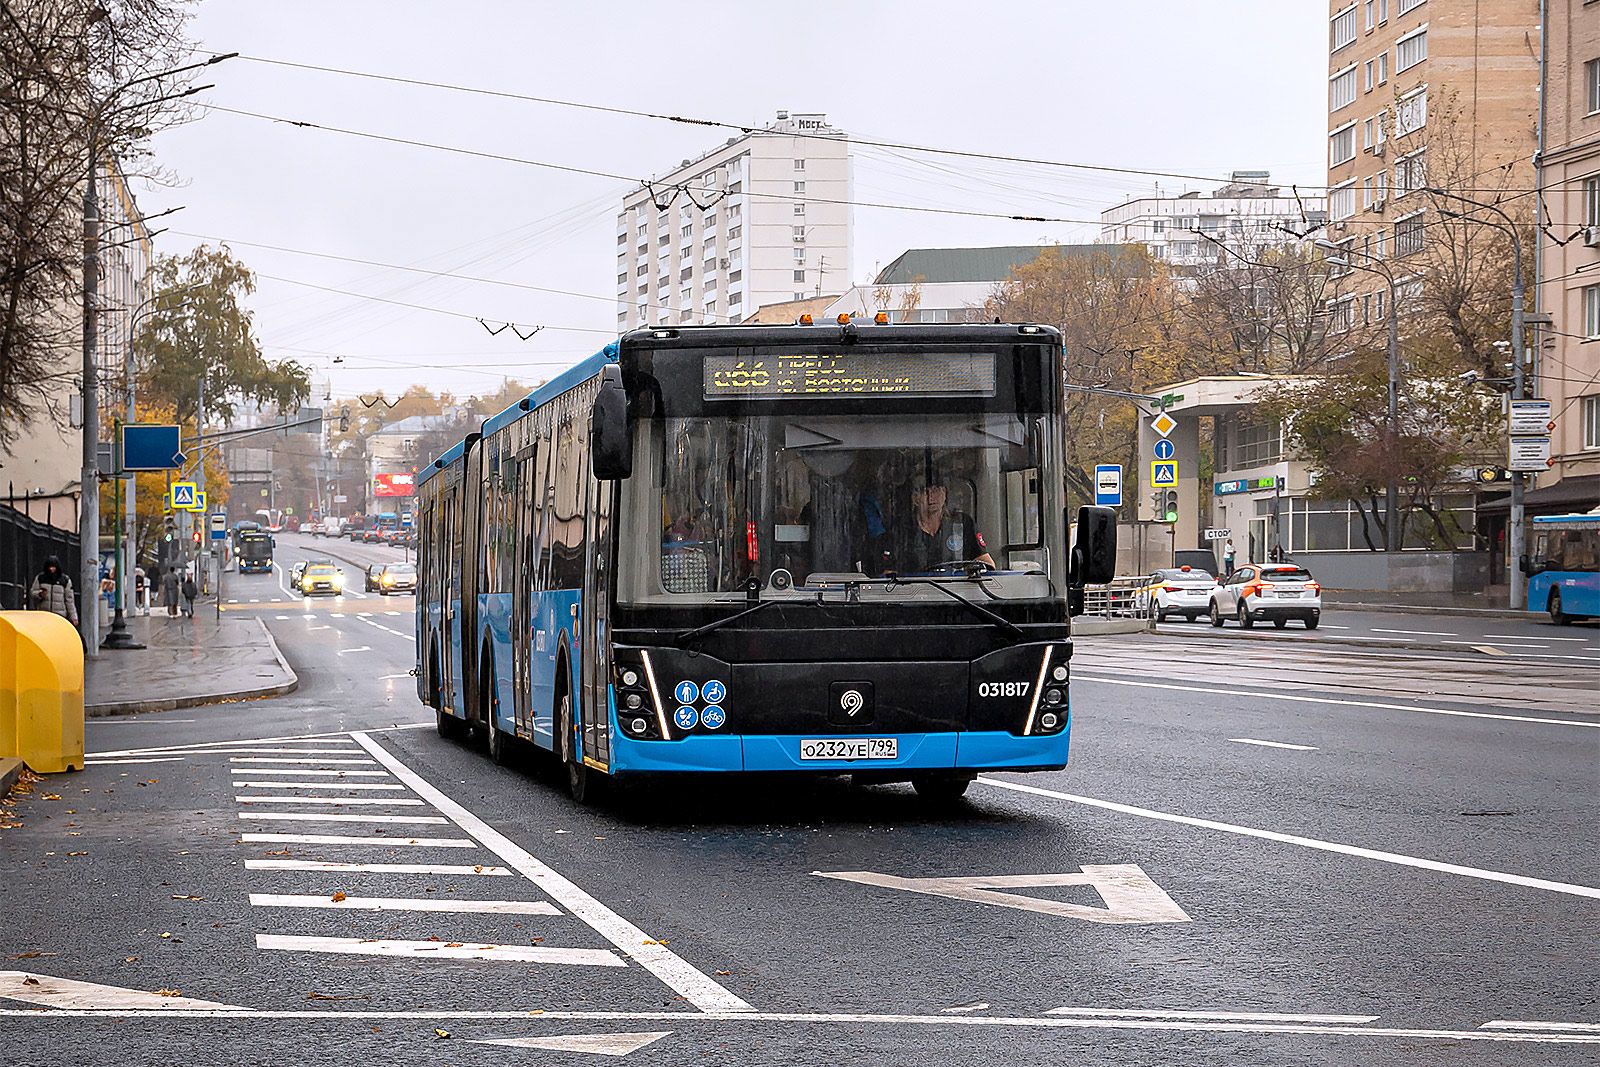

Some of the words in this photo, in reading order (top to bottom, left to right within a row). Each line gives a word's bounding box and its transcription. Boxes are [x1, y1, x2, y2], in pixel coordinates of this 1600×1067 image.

[979, 682, 1030, 697] 031817
[805, 741, 867, 757] О232УЕ
[869, 740, 893, 752] 799
